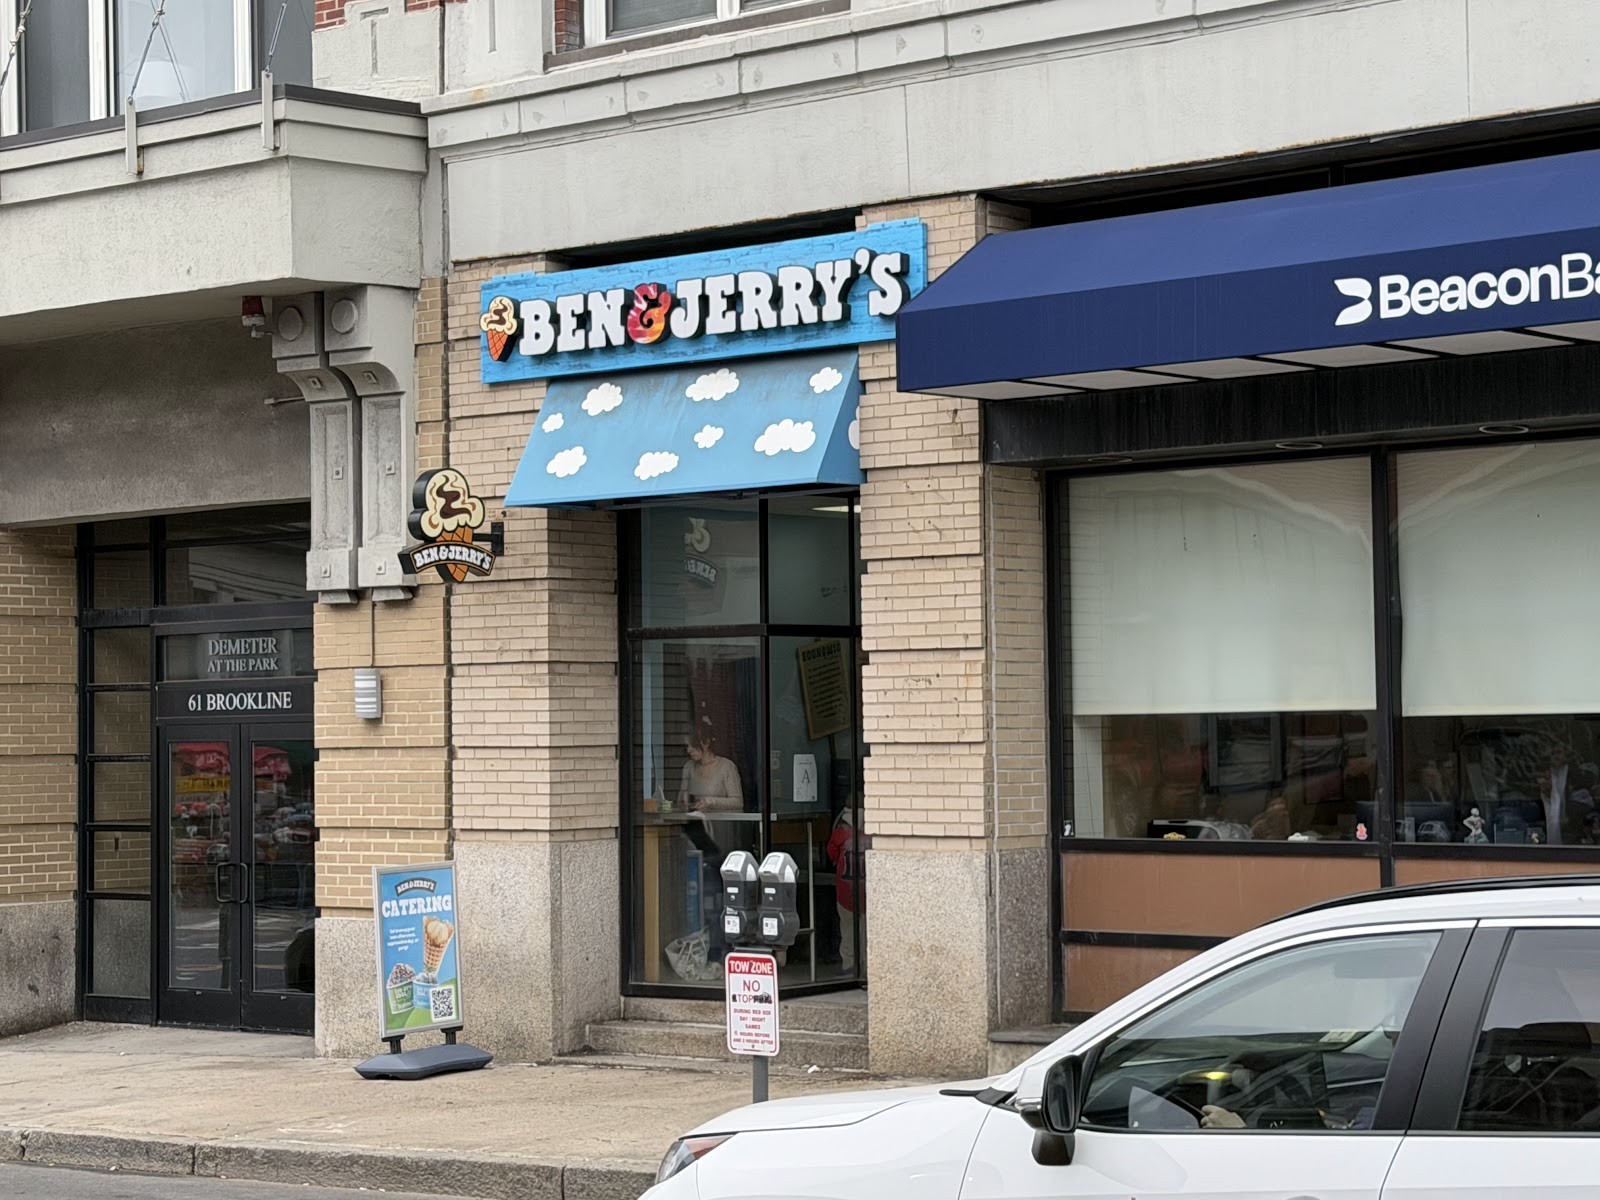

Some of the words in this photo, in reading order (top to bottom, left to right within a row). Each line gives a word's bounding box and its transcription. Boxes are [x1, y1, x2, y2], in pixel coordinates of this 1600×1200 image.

[1379, 252, 1600, 319] BeaconB
[208, 637, 278, 656] DEMETER
[208, 659, 223, 673] AT
[225, 659, 247, 672] THE
[248, 658, 279, 671] PARK
[188, 694, 202, 711] 61
[206, 691, 292, 711] BROOKLINE
[382, 895, 452, 918] CATERING
[730, 961, 750, 973] TOW
[750, 961, 773, 974] ZONE
[743, 980, 760, 993] NO
